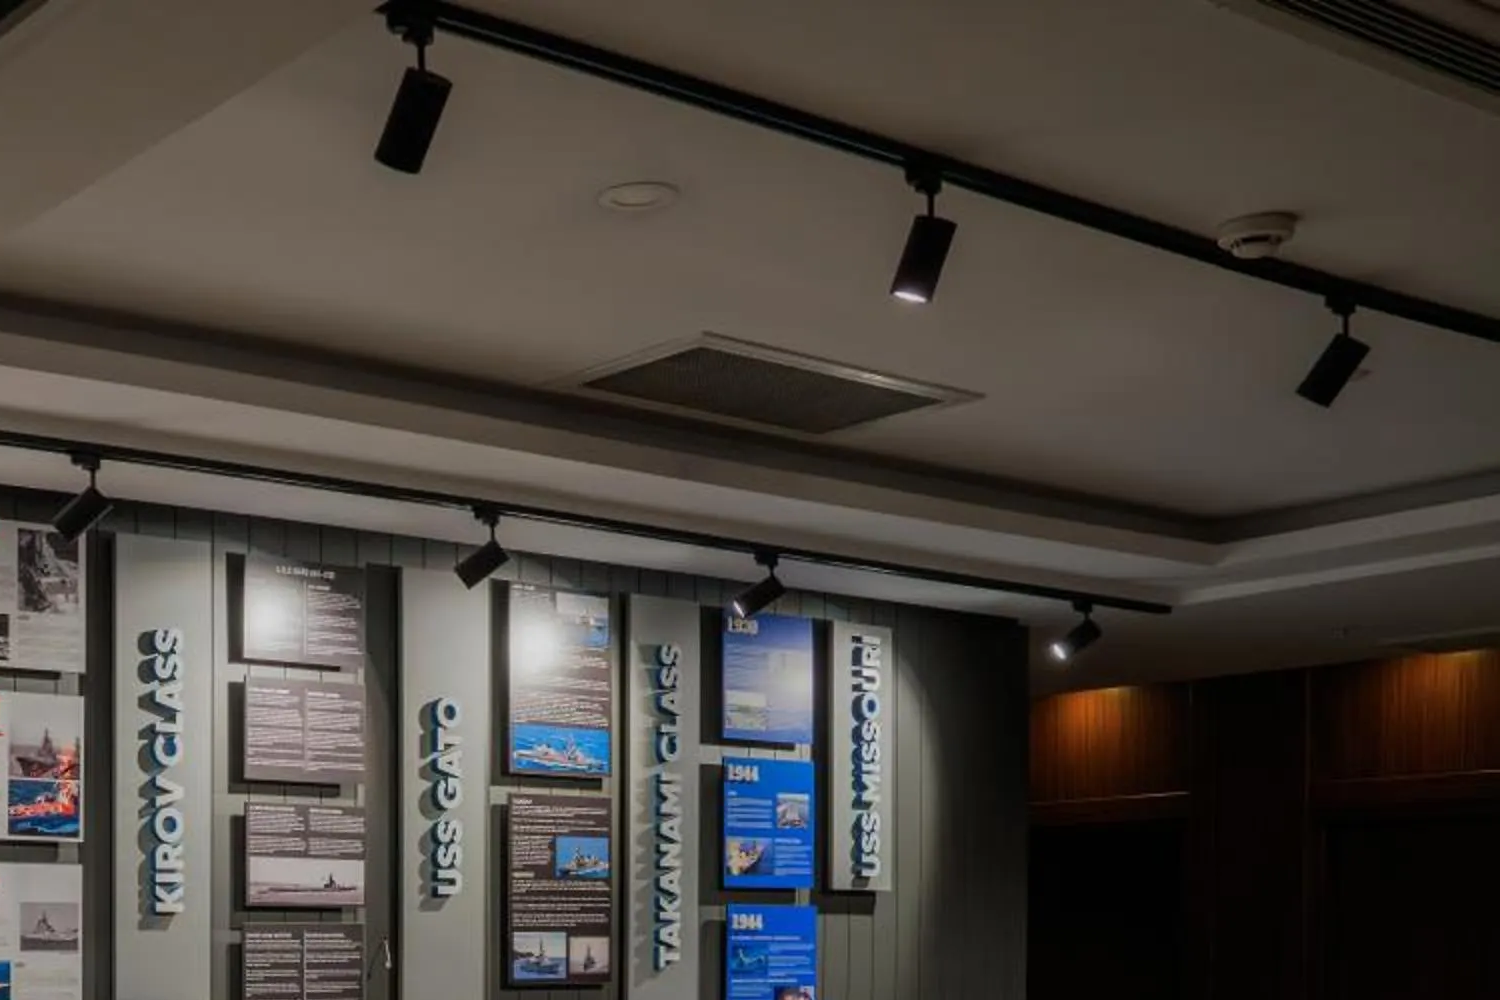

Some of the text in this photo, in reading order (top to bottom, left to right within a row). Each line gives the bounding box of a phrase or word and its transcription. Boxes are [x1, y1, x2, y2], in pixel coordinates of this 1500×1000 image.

[153, 627, 185, 914] KIROV CLASS
[436, 697, 463, 896] USS GATO
[657, 643, 682, 970] TAKANAMI CLASS
[861, 634, 881, 878] USS MISSOURI
